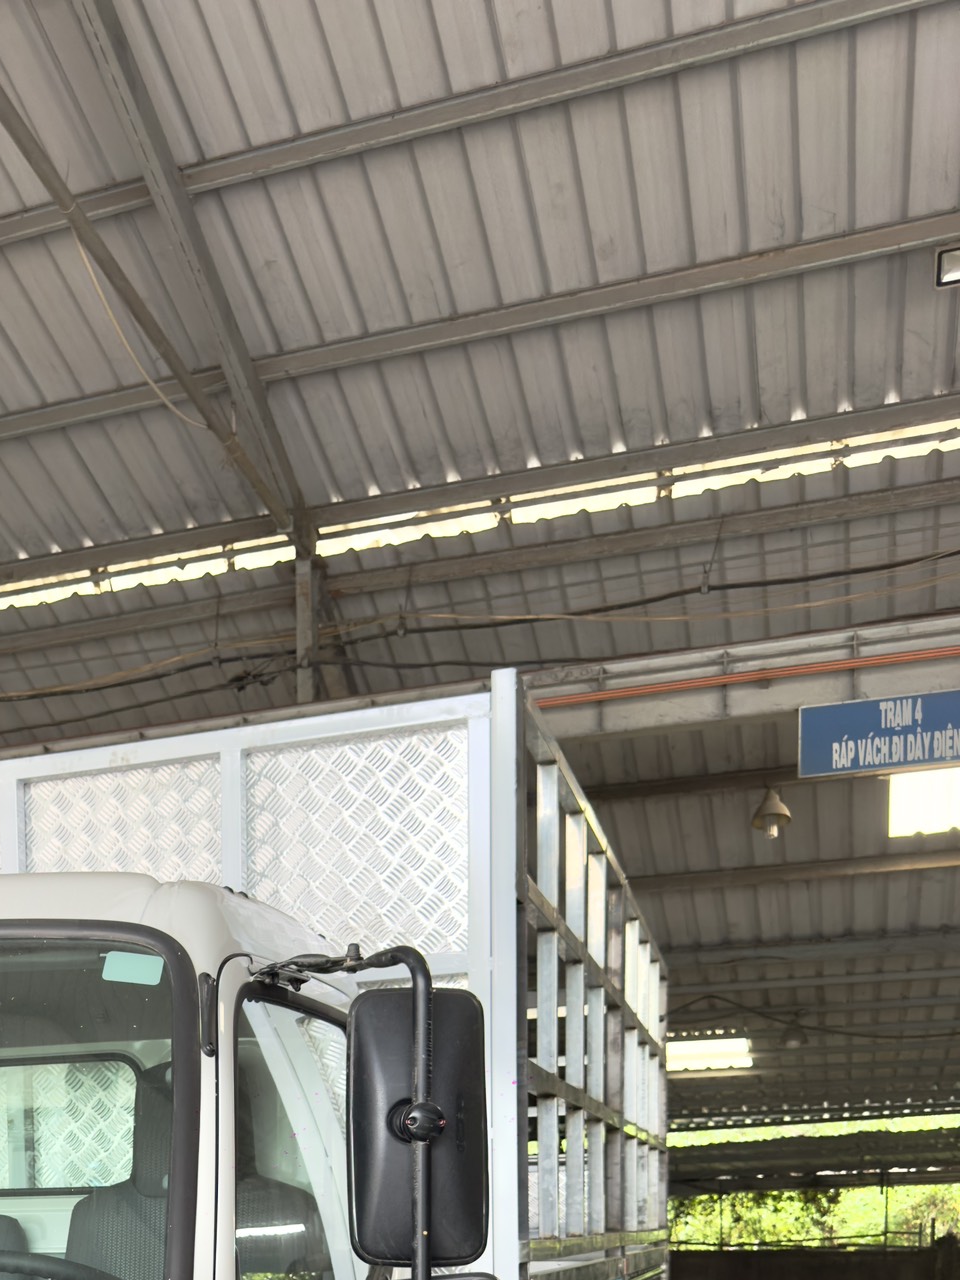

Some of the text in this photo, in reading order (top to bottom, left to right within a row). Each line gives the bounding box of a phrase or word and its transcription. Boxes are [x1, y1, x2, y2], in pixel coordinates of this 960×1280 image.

[879, 697, 923, 731] TRẠM 4
[832, 734, 855, 769] RÁP
[906, 726, 932, 761] DÂY
